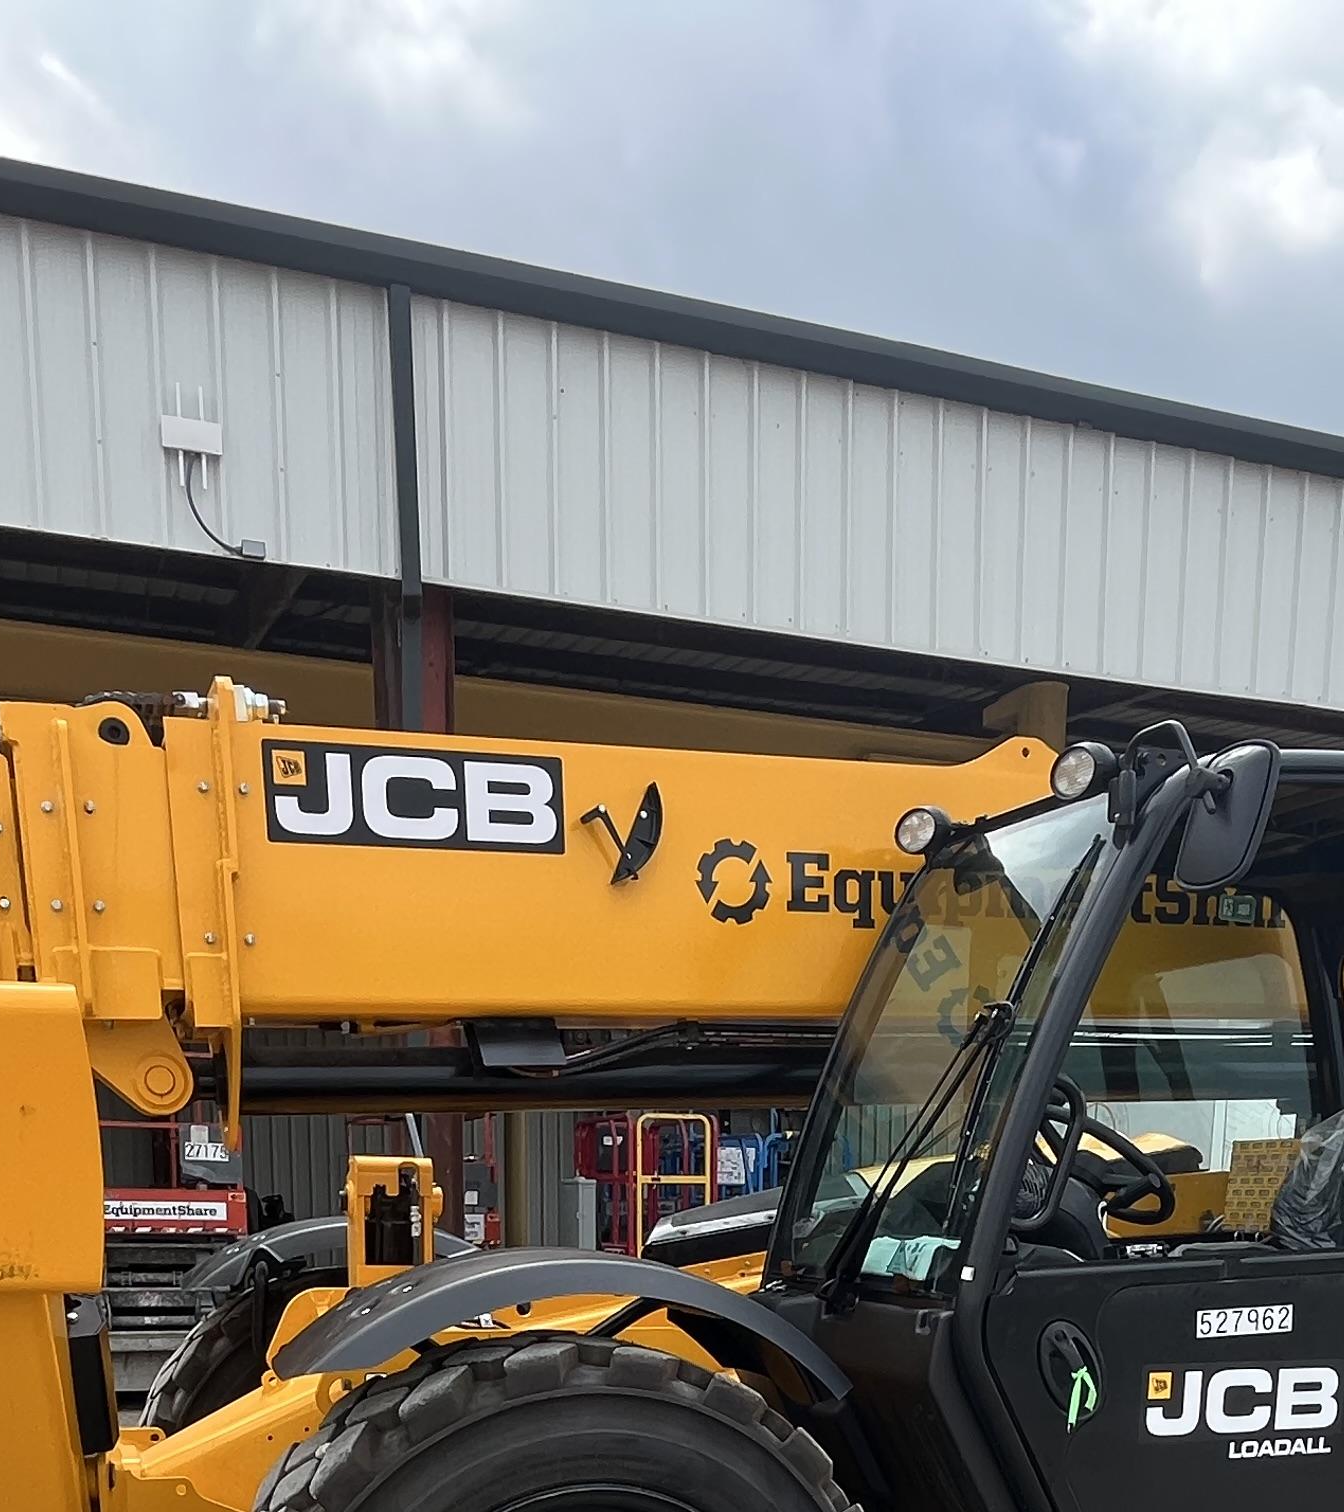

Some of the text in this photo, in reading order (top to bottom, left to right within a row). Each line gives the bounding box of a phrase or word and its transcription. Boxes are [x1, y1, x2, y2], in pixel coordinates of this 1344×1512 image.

[274, 752, 558, 844] JCB
[104, 1203, 218, 1218] EquipmentShare
[1199, 1306, 1291, 1336] 527962
[1145, 1367, 1340, 1437] JCB
[1228, 1436, 1332, 1460] LOADALL
